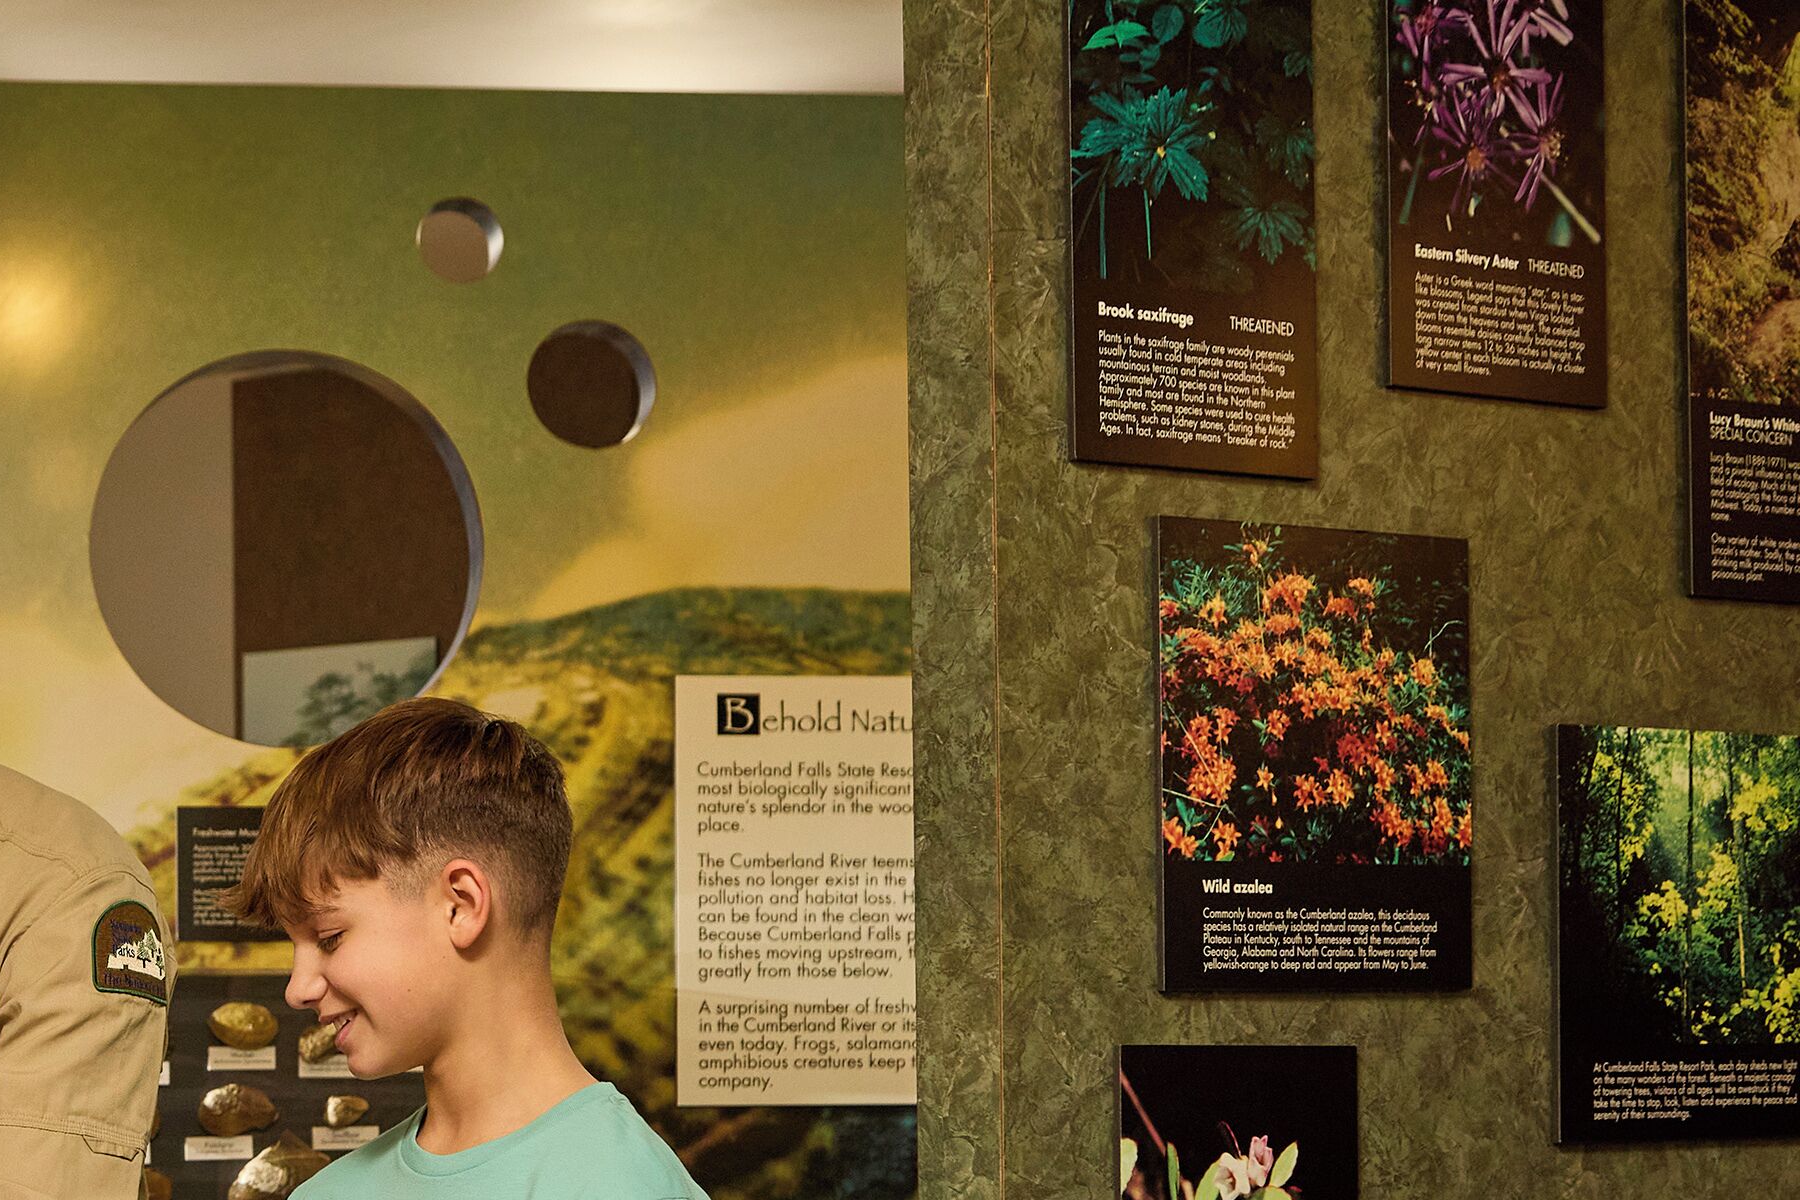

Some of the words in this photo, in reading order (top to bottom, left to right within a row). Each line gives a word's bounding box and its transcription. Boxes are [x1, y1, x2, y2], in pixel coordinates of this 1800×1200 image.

[1415, 244, 1453, 262] Eastern
[1456, 249, 1490, 270] Silvery
[1492, 254, 1520, 270] Aster
[1528, 258, 1584, 279] THREATENED
[1098, 301, 1134, 320] Brook
[1137, 306, 1194, 329] saxifrage
[1230, 316, 1294, 337] THREATENED
[1098, 330, 1122, 344] Plants
[1123, 334, 1132, 345] in
[1133, 334, 1146, 346] the
[1147, 337, 1184, 353] saxifrage
[1186, 339, 1210, 356] family
[1211, 346, 1225, 355] are
[1226, 345, 1254, 360] woody
[1255, 350, 1294, 362] perennials
[1710, 411, 1731, 430] Lucy
[1734, 414, 1770, 430] Braun's
[1772, 417, 1800, 432] White
[1710, 426, 1744, 442] SPECIAL
[1746, 430, 1793, 446] CONCERN
[719, 694, 842, 734] Behold
[850, 709, 914, 732] Natu
[697, 761, 792, 777] Cumberland
[798, 761, 832, 777] Falls
[837, 761, 875, 777] State
[698, 781, 732, 795] most
[738, 780, 828, 800] biologically
[833, 780, 911, 800] significant
[698, 798, 756, 814] nature's
[761, 798, 825, 818] splendor
[832, 799, 845, 814] in
[850, 798, 873, 814] the
[878, 803, 914, 813] woo
[698, 817, 745, 836] place.
[698, 852, 724, 868] The
[729, 852, 824, 868] Cumberland
[830, 852, 866, 868] River
[872, 854, 915, 868] teems
[698, 870, 740, 886] fishes
[746, 875, 766, 886] no
[770, 870, 818, 890] longer
[825, 872, 859, 886] exist
[865, 872, 878, 886] in
[884, 870, 908, 886] the
[1202, 879, 1230, 894] Wild
[1234, 880, 1273, 894] azalea
[698, 889, 764, 909] pollution
[769, 889, 799, 905] and
[805, 889, 858, 905] habitat
[864, 889, 897, 904] loss.
[698, 912, 725, 923] can
[730, 907, 750, 923] be
[755, 907, 798, 923] found
[803, 908, 816, 923] in
[822, 907, 844, 923] the
[849, 907, 890, 923] clean
[1202, 907, 1245, 922] Commonly
[1246, 908, 1273, 920] known
[1274, 912, 1284, 920] as
[1285, 908, 1298, 920] the
[1299, 908, 1346, 920] Cumberland
[1347, 908, 1376, 921] azalea,
[1377, 908, 1391, 920] this
[1392, 908, 1430, 921] deciduous
[698, 926, 762, 941] Because
[766, 925, 862, 941] Cumberland
[867, 925, 902, 941] Falls
[698, 945, 712, 960] to
[718, 944, 760, 960] fishes
[766, 945, 822, 964] moving
[828, 945, 903, 964] upstream,
[698, 962, 751, 982] greatly
[756, 962, 791, 978] from
[796, 962, 837, 978] those
[842, 962, 894, 977] below.
[698, 999, 711, 1014] A
[716, 1000, 788, 1018] surprising
[793, 998, 848, 1014] number
[854, 998, 869, 1014] of
[698, 1018, 712, 1032] in
[716, 1017, 739, 1032] the
[743, 1016, 836, 1032] Cumberland
[840, 1016, 876, 1032] River
[881, 1021, 896, 1032] or
[902, 1018, 917, 1032] its
[698, 1040, 734, 1050] even
[740, 1035, 787, 1054] today.
[794, 1034, 840, 1054] Frogs,
[698, 1053, 788, 1073] amphibious
[793, 1054, 863, 1068] creatures
[868, 1052, 906, 1072] keep
[698, 1076, 774, 1091] company.
